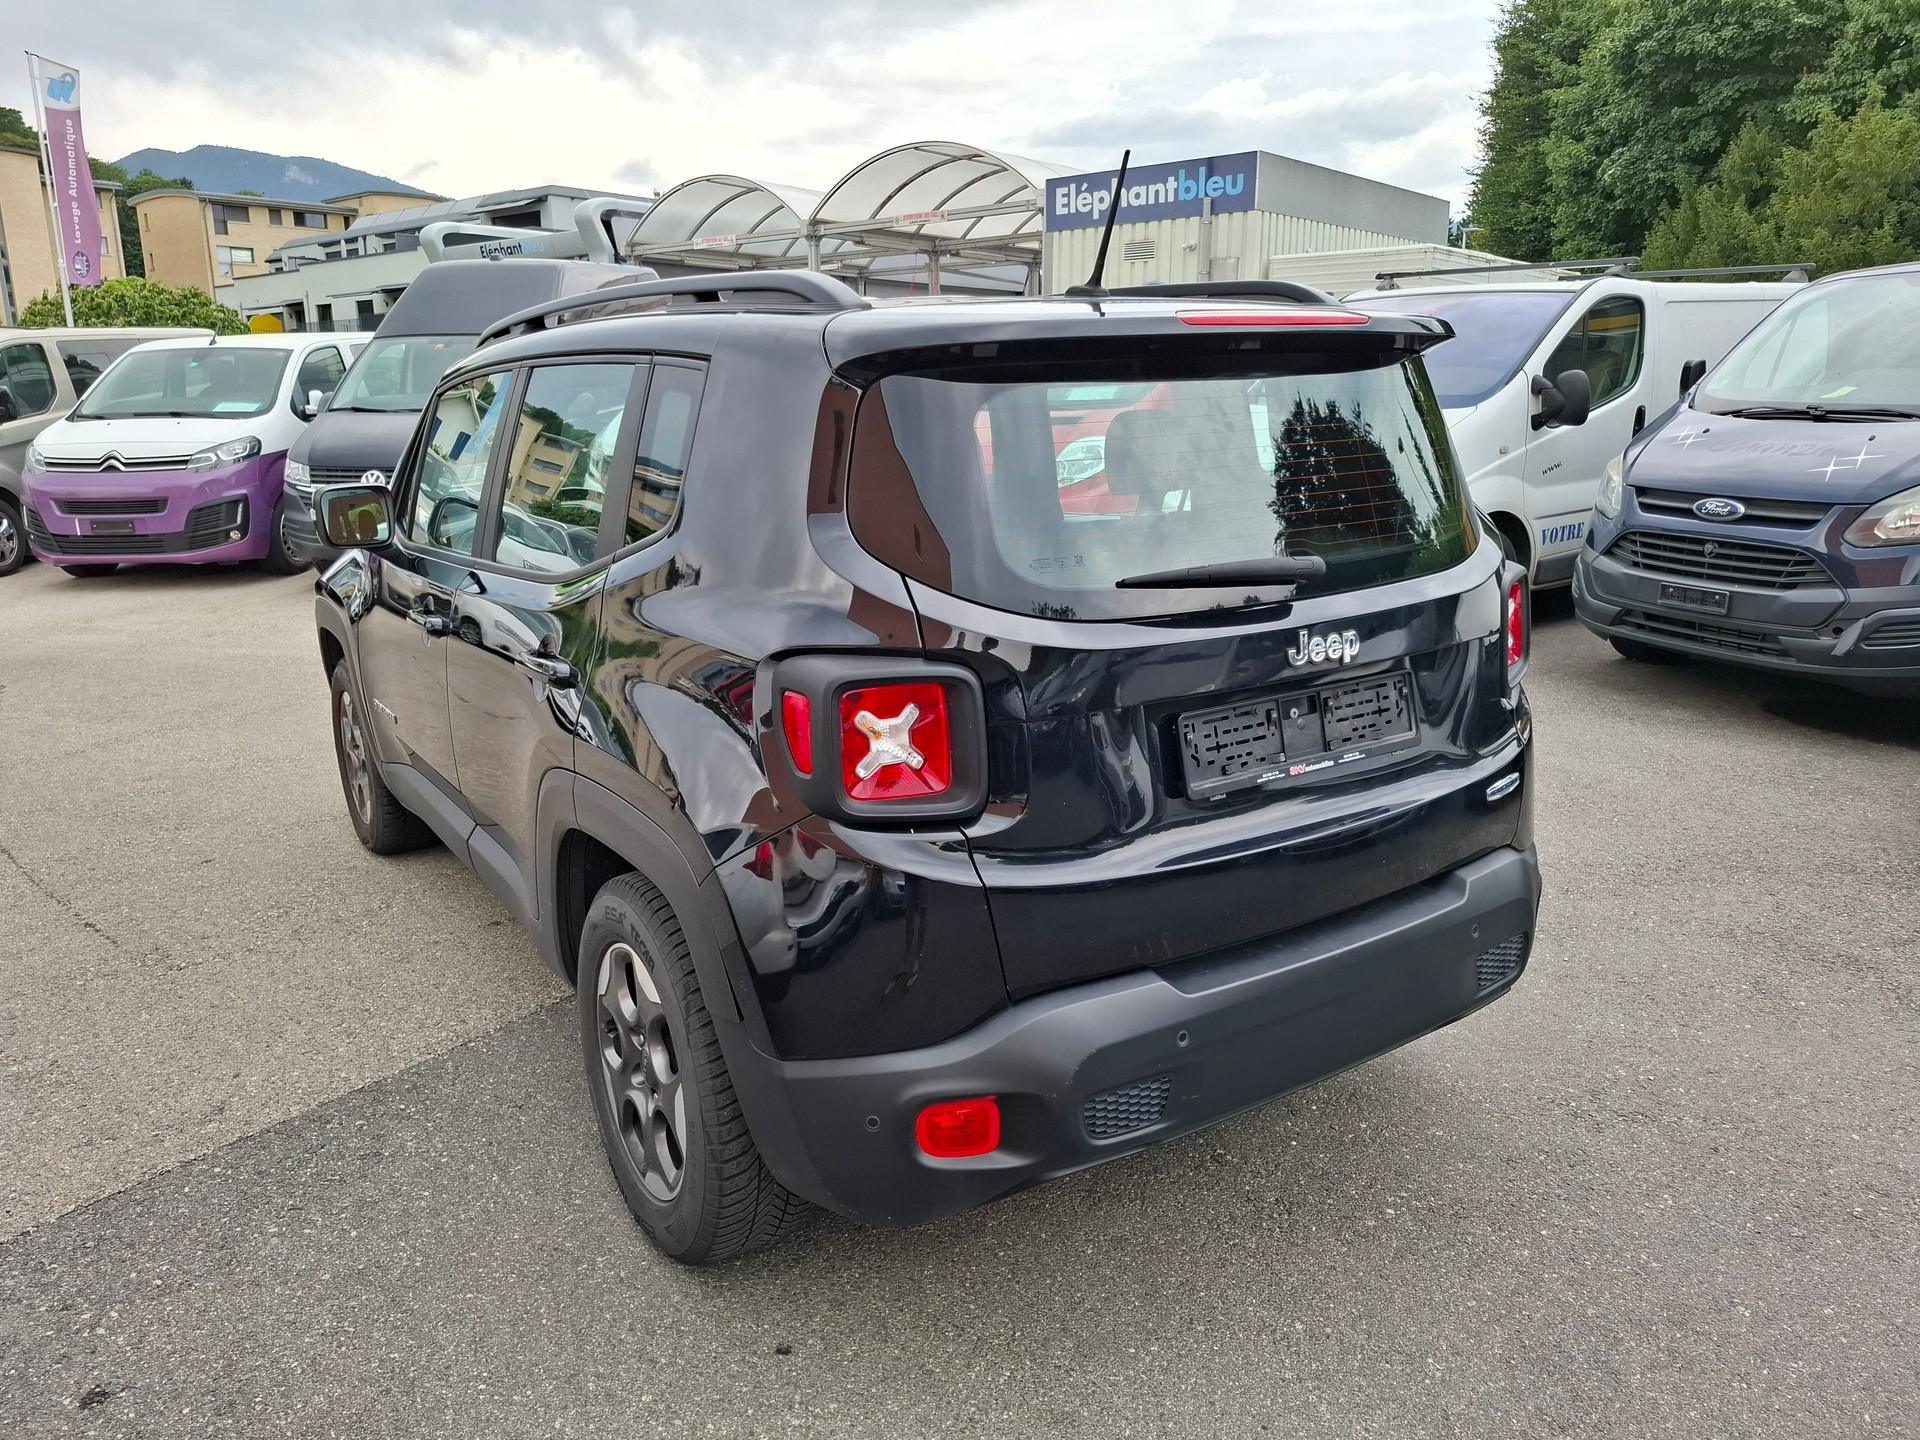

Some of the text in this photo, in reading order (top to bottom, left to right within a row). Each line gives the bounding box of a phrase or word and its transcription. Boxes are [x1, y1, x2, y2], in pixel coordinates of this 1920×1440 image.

[64, 118, 81, 244] Lavage Automatique
[1701, 501, 1732, 516] Ford
[1541, 522, 1585, 546] VOTRE
[1287, 629, 1361, 667] Jeep
[630, 922, 656, 974] TECAR
